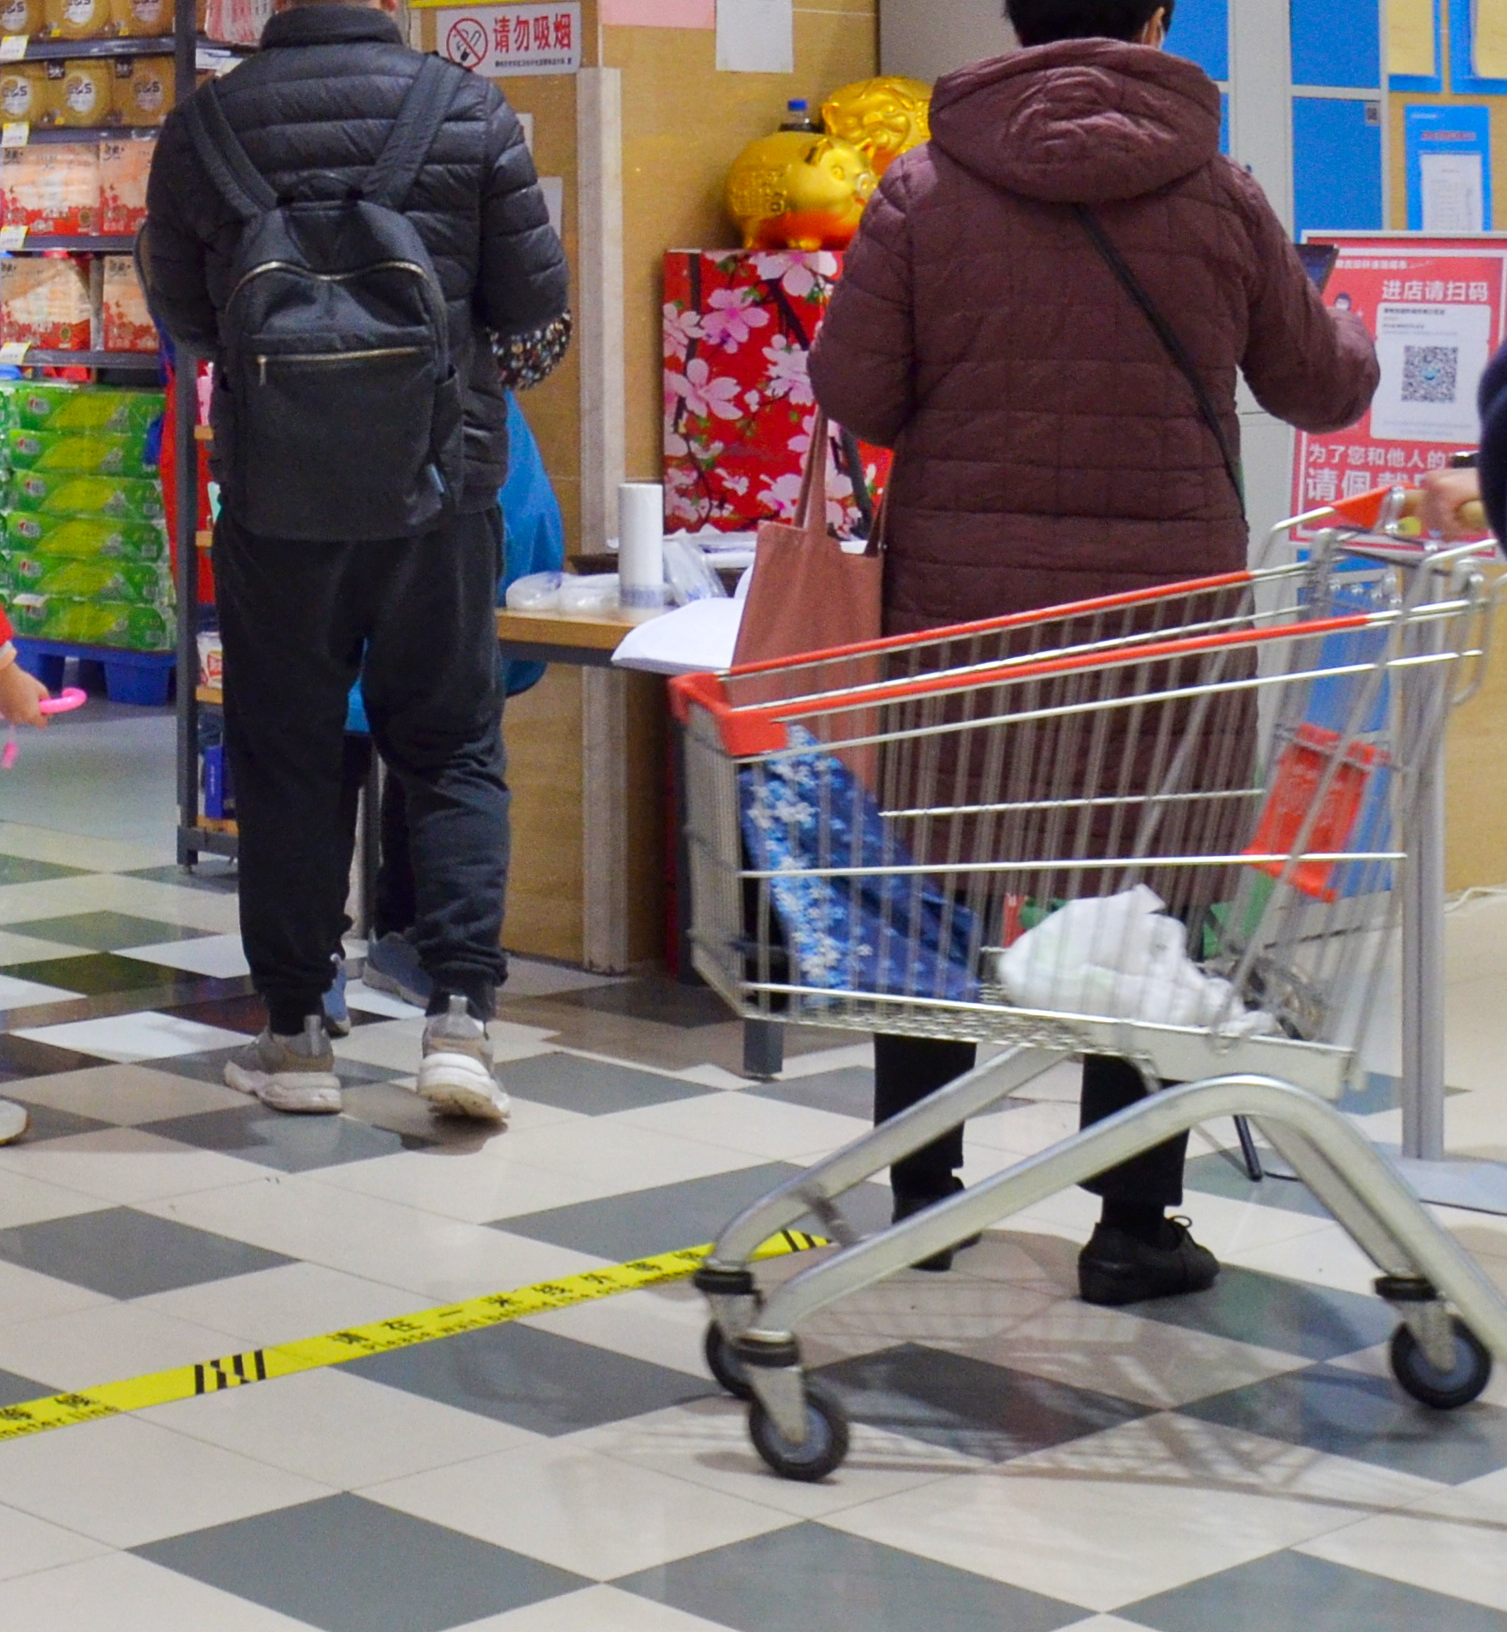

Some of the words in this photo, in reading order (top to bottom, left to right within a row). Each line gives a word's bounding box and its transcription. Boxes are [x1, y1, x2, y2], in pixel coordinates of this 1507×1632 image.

[493, 12, 572, 54] 请勿吸烟
[1381, 278, 1490, 303] 进店请扫码
[1307, 442, 1459, 470] 为了您和他人的
